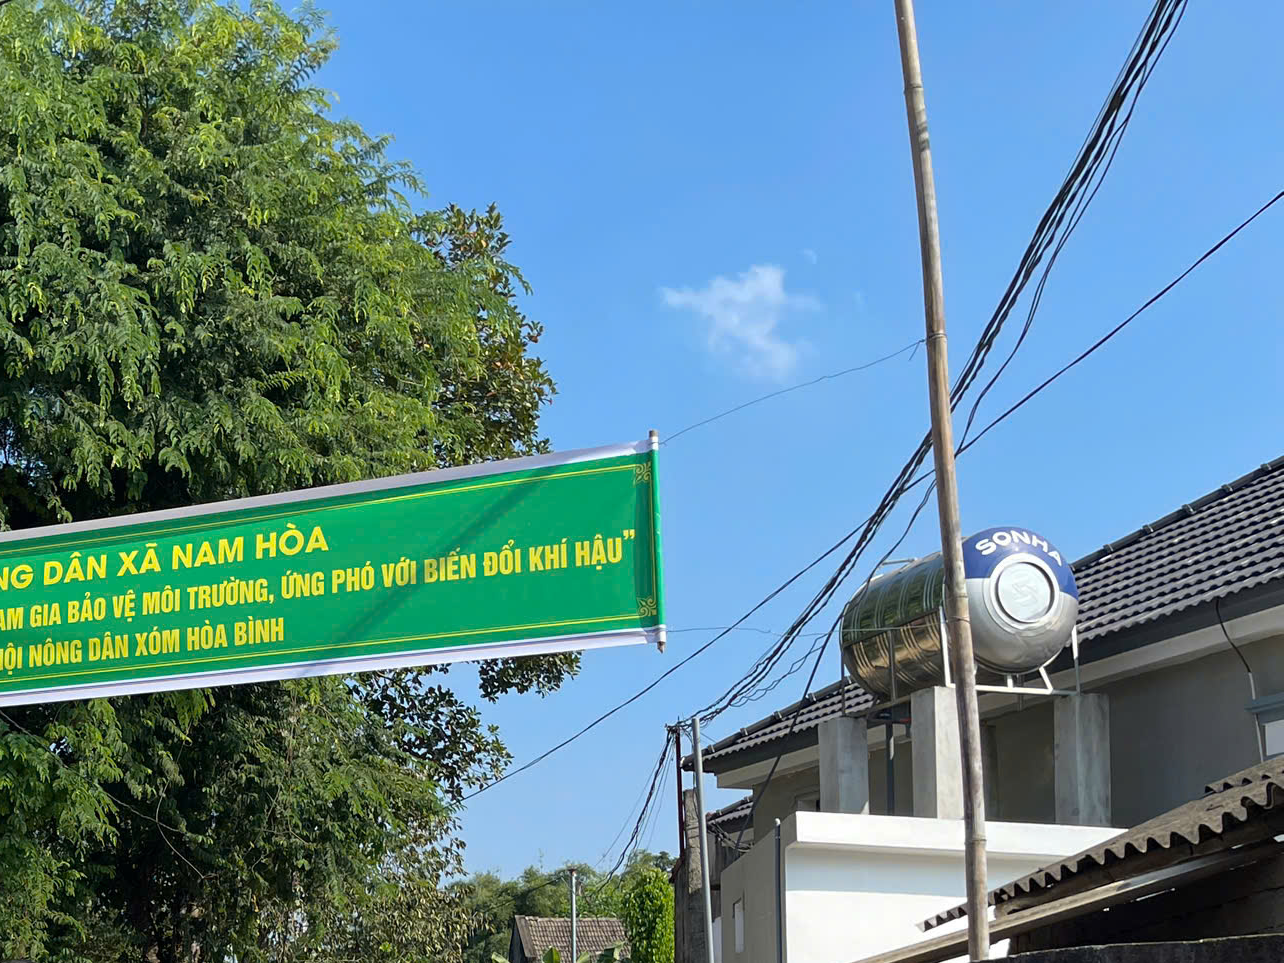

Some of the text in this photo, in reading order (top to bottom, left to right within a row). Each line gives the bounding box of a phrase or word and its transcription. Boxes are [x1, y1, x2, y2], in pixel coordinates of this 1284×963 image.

[30, 602, 61, 628] GIA
[67, 592, 106, 623] BẢO
[113, 589, 136, 623] VỆ
[142, 584, 181, 614] MÔI
[187, 576, 274, 609] TRƯỜNG,
[281, 570, 325, 599] ỨNG
[331, 560, 374, 593] PHÓ
[381, 556, 416, 588] VỚI
[423, 546, 476, 583] BIẾN
[483, 538, 522, 576] ĐỔI
[529, 537, 567, 572] KHÍ
[43, 551, 108, 586] DÂN
[117, 542, 161, 577] XÃ
[172, 536, 244, 570] NAM
[256, 523, 329, 559] HÒA
[28, 638, 82, 668] NÔNG
[88, 632, 129, 661] DÂN
[135, 627, 180, 657] XÓM
[187, 619, 228, 651] HÒA
[234, 616, 284, 646] BÌNH
